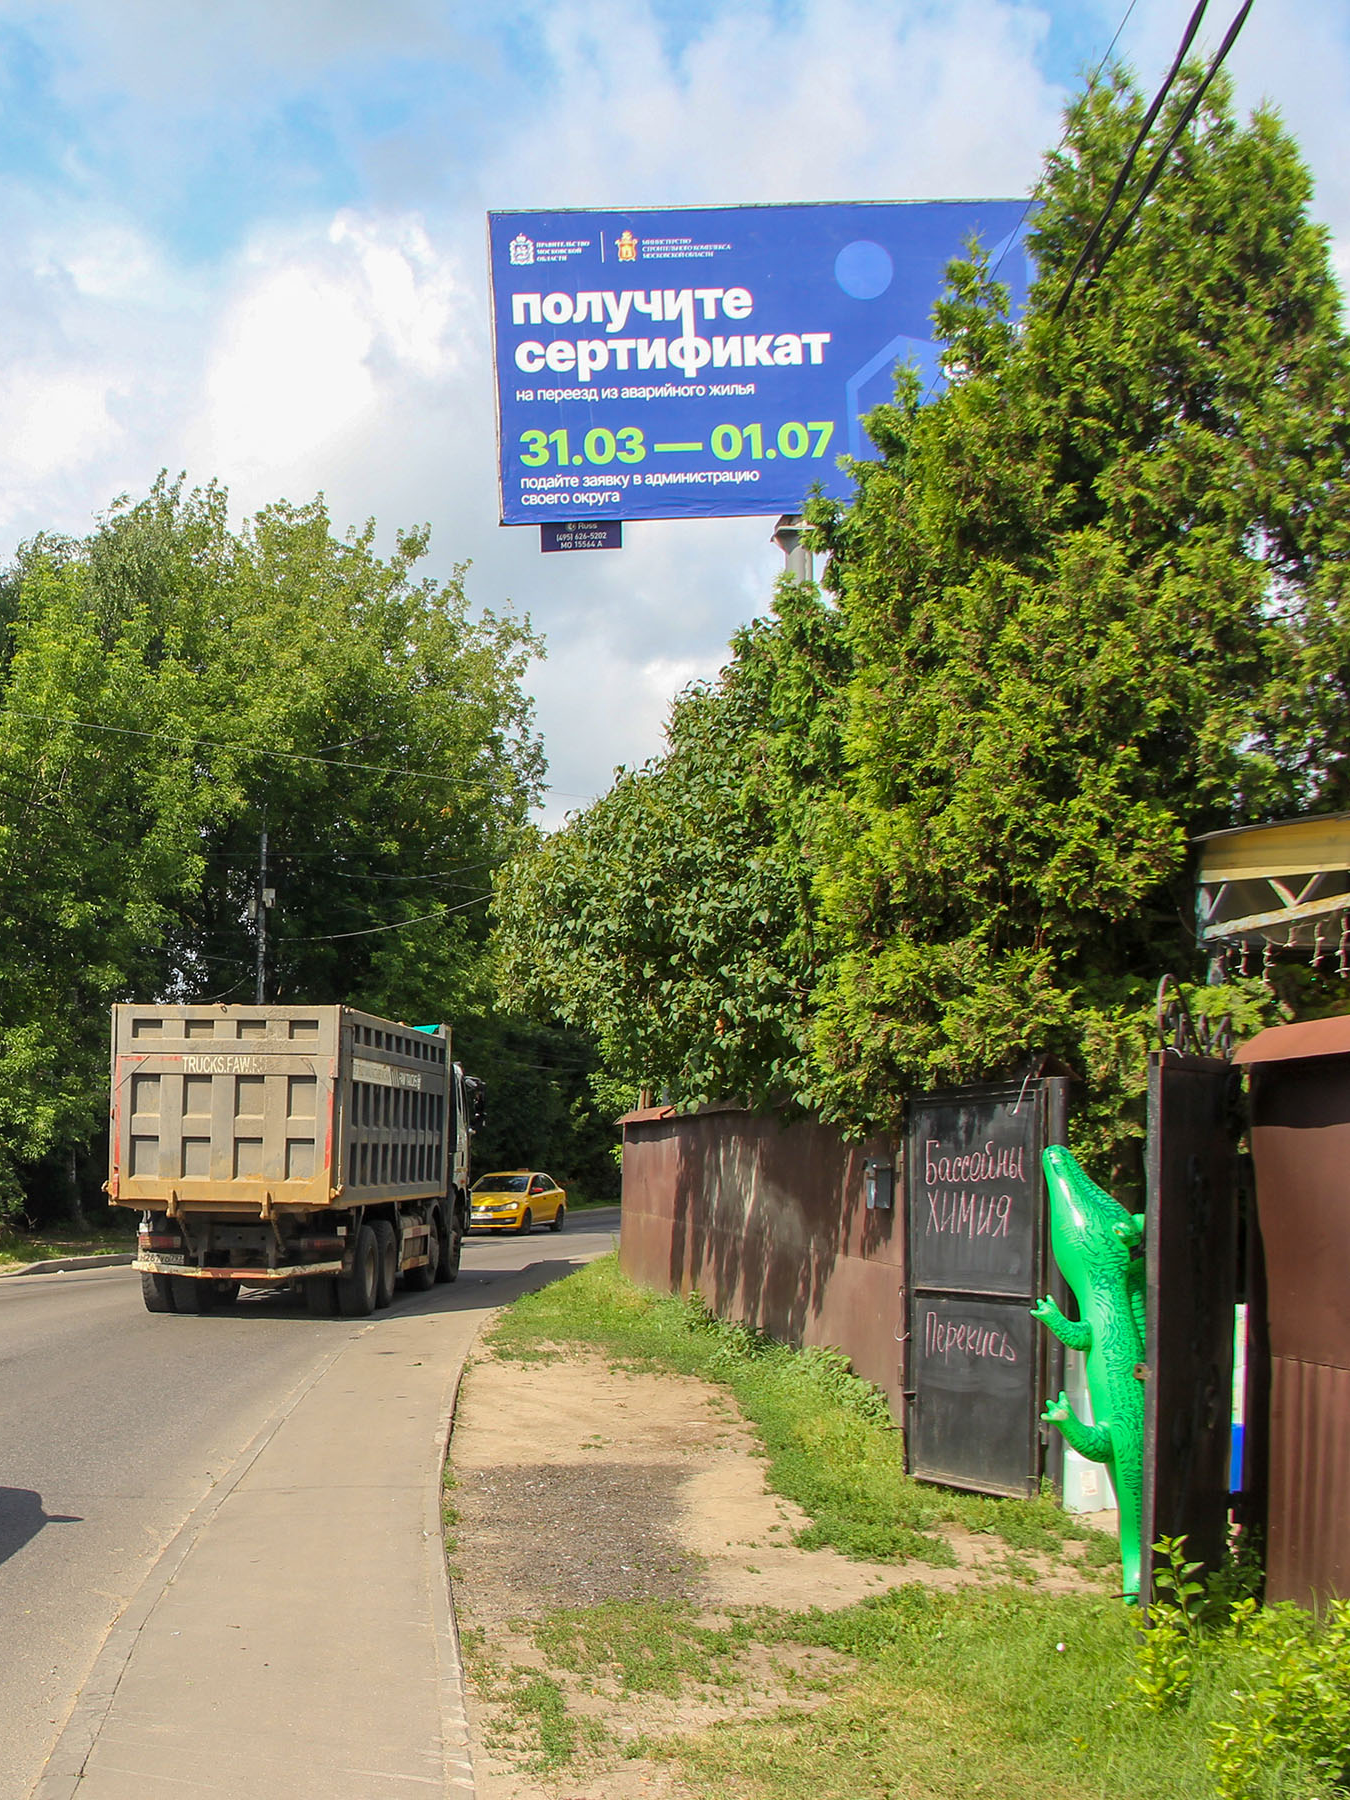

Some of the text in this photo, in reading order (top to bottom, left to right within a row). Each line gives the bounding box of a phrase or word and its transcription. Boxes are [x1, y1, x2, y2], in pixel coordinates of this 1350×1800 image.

[512, 287, 753, 333] получите
[515, 332, 831, 382] сертификат
[516, 383, 755, 403] на переезд из аварийного жилья
[519, 427, 646, 467] 31.03
[710, 421, 834, 461] 01.07
[521, 470, 760, 490] подайте заявку в администрацию
[521, 491, 620, 506] своего округа
[556, 533, 573, 542] (495)
[925, 1139, 1026, 1186] Бассейны
[926, 1189, 1012, 1239] ХИМИЯ
[925, 1311, 1017, 1365] Перекись
